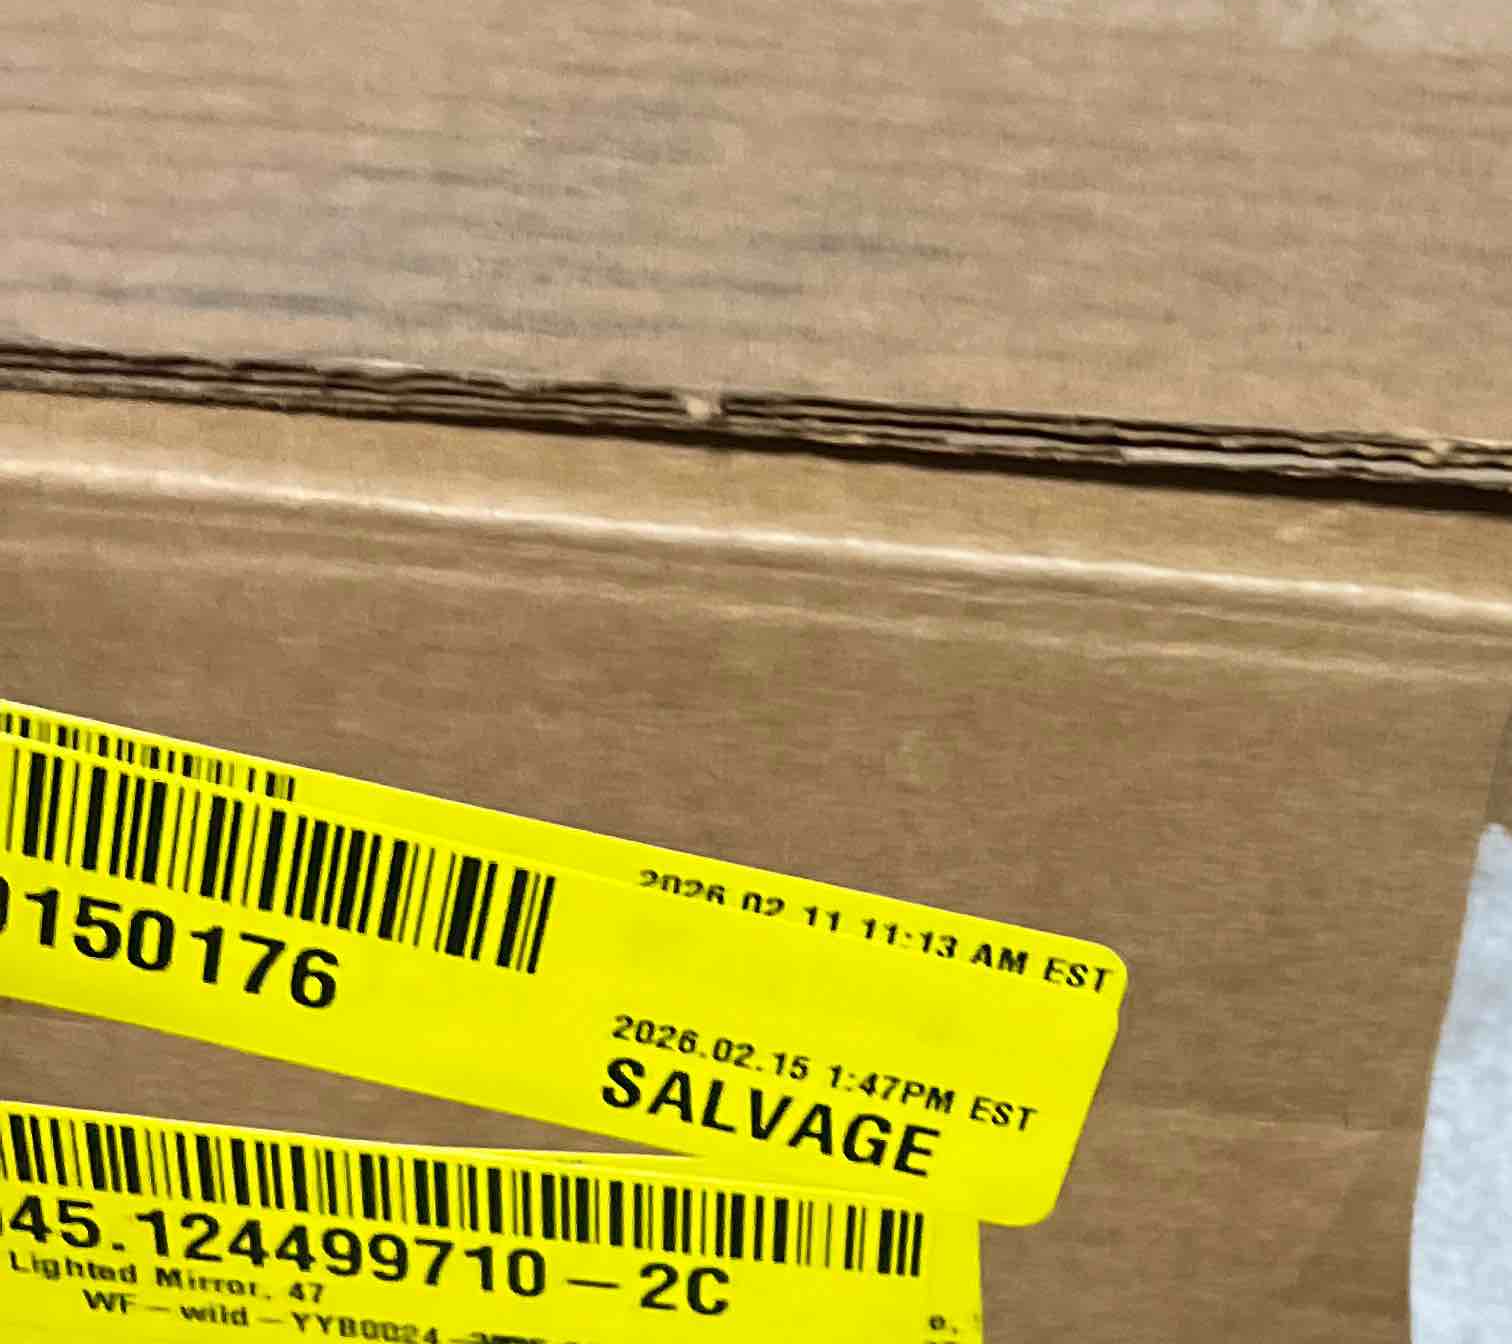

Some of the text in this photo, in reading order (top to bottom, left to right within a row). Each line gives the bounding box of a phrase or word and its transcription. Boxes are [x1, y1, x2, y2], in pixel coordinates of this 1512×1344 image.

[970, 943, 1030, 976] AM
[1043, 956, 1114, 993] EST
[601, 1056, 942, 1177] SALVAGE
[611, 1013, 1040, 1134] 2026.02.15 1:47PM EST
[0, 1193, 731, 1317] 45.124499710-2C
[9, 1249, 138, 1284] Lighted
